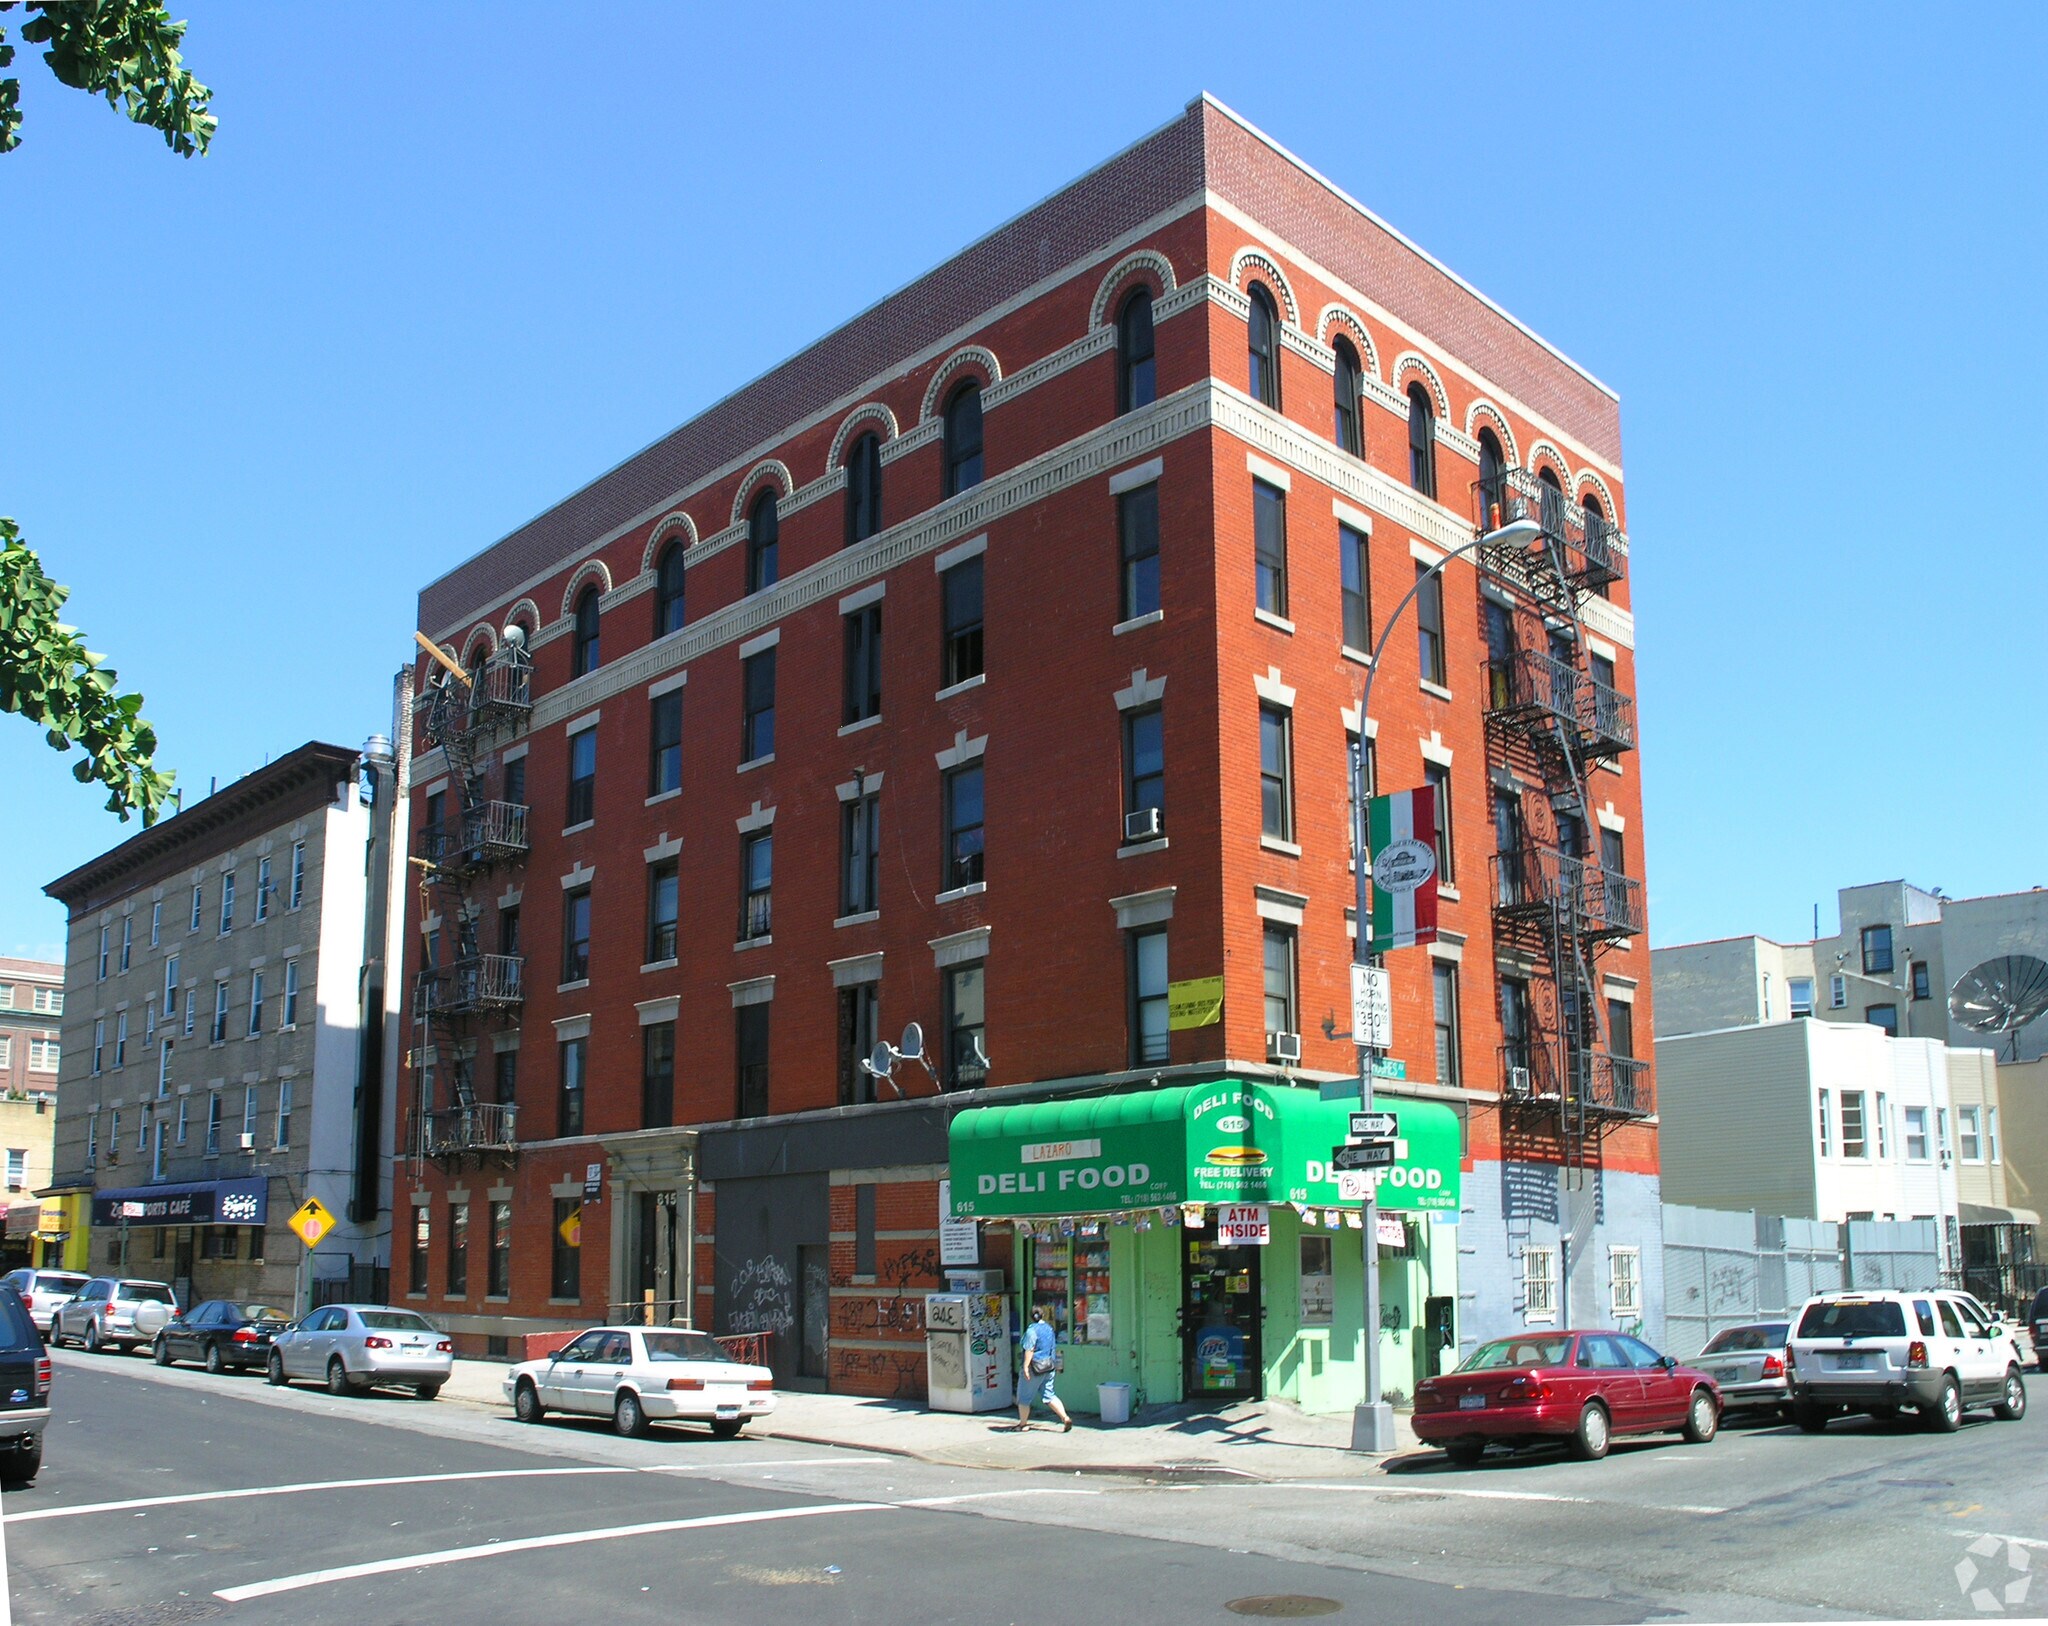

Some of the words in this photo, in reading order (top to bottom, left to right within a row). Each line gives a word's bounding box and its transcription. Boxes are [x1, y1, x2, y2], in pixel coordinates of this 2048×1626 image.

[1362, 971, 1378, 987] NO
[1360, 988, 1382, 999] HORN
[1355, 999, 1388, 1013] HONKING
[1363, 1028, 1380, 1040] FINE
[1193, 1092, 1227, 1120] DELI
[1232, 1092, 1274, 1120] FOOD
[1222, 1120, 1243, 1129] 615
[1354, 1120, 1368, 1130] ONE
[1370, 1120, 1384, 1130] WAY
[1032, 1142, 1073, 1160] LAZARO
[1341, 1153, 1358, 1162] ONE
[1366, 1149, 1385, 1160] WAY
[978, 1171, 1046, 1195] DELI
[1058, 1163, 1150, 1191] FOOD
[1193, 1167, 1221, 1178] FREE
[1222, 1167, 1274, 1178] DELIVERY
[1375, 1166, 1442, 1189] FOOD
[656, 1193, 677, 1206] 615
[1289, 1188, 1307, 1200] 615
[144, 1203, 167, 1216] PORTS
[956, 1201, 975, 1213] 615
[1228, 1207, 1259, 1222] ATM
[1219, 1223, 1268, 1238] INSIDE
[965, 1280, 981, 1291] ICE
